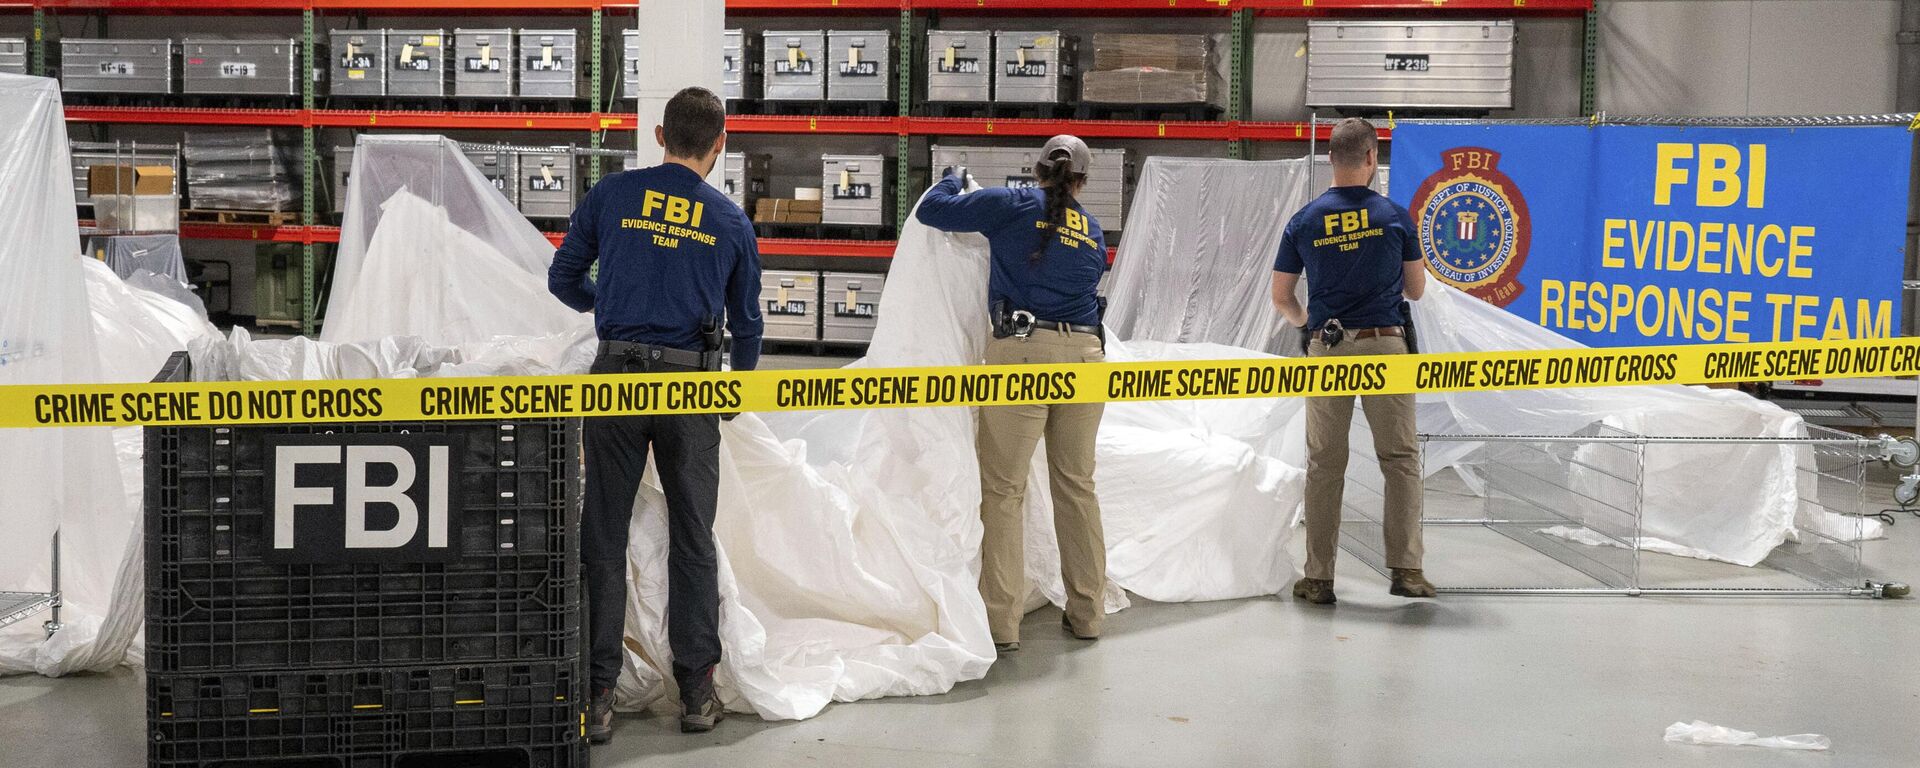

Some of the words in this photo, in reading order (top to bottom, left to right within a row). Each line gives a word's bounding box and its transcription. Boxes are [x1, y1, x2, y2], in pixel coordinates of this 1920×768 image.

[1451, 151, 1492, 171] FBI
[1653, 142, 1767, 209] FBI
[642, 189, 704, 228] FBI
[1456, 183, 1470, 192] OF
[1472, 184, 1508, 214] JUSTICE
[622, 218, 667, 233] EVIDENCE
[668, 225, 717, 246] RESPONSE
[1066, 208, 1089, 236] BI
[1313, 234, 1347, 247] EVIDENCE
[1348, 228, 1384, 241] RESPONSE
[1324, 208, 1369, 235] FBI
[652, 235, 679, 248] TEAM
[1060, 235, 1079, 248] TEAM
[1339, 242, 1359, 252] TEAM
[1422, 213, 1432, 257] FEDERAL
[1431, 257, 1462, 281] BUREAU
[1464, 273, 1475, 282] OF
[1478, 217, 1514, 279] INVESTIGATION
[1602, 218, 1815, 279] EVIDENCE
[1540, 279, 1752, 343] RESPONSE
[1766, 294, 1893, 341] TEAM
[1108, 369, 1173, 398] CRIME
[1176, 367, 1242, 396] SCENE
[1245, 366, 1275, 394] DO
[1277, 365, 1319, 393] NOT
[1320, 362, 1387, 392] CROSS
[1416, 360, 1478, 389] CRIME
[1480, 358, 1542, 387] SCENE
[1545, 357, 1573, 384] DO
[1575, 355, 1614, 384] NOT
[1615, 353, 1678, 382] CROSS
[1704, 351, 1762, 379] CRIME
[1764, 348, 1823, 377] SCENE
[1825, 347, 1851, 374] DO
[1853, 346, 1890, 373] NOT
[34, 393, 117, 424] CRIME
[121, 391, 201, 422] SCENE
[209, 391, 243, 420] DO
[248, 389, 297, 420] NOT
[301, 387, 383, 418] CROSS
[420, 385, 495, 416] CRIME
[500, 383, 573, 415] SCENE
[581, 383, 612, 412] DO
[617, 381, 663, 411] NOT
[666, 380, 742, 410] CROSS
[776, 378, 846, 407] CRIME
[850, 376, 919, 406] SCENE
[926, 375, 955, 403] DO
[959, 373, 1004, 402] NOT
[1006, 371, 1076, 402] CROSS
[274, 445, 449, 549] FBI
